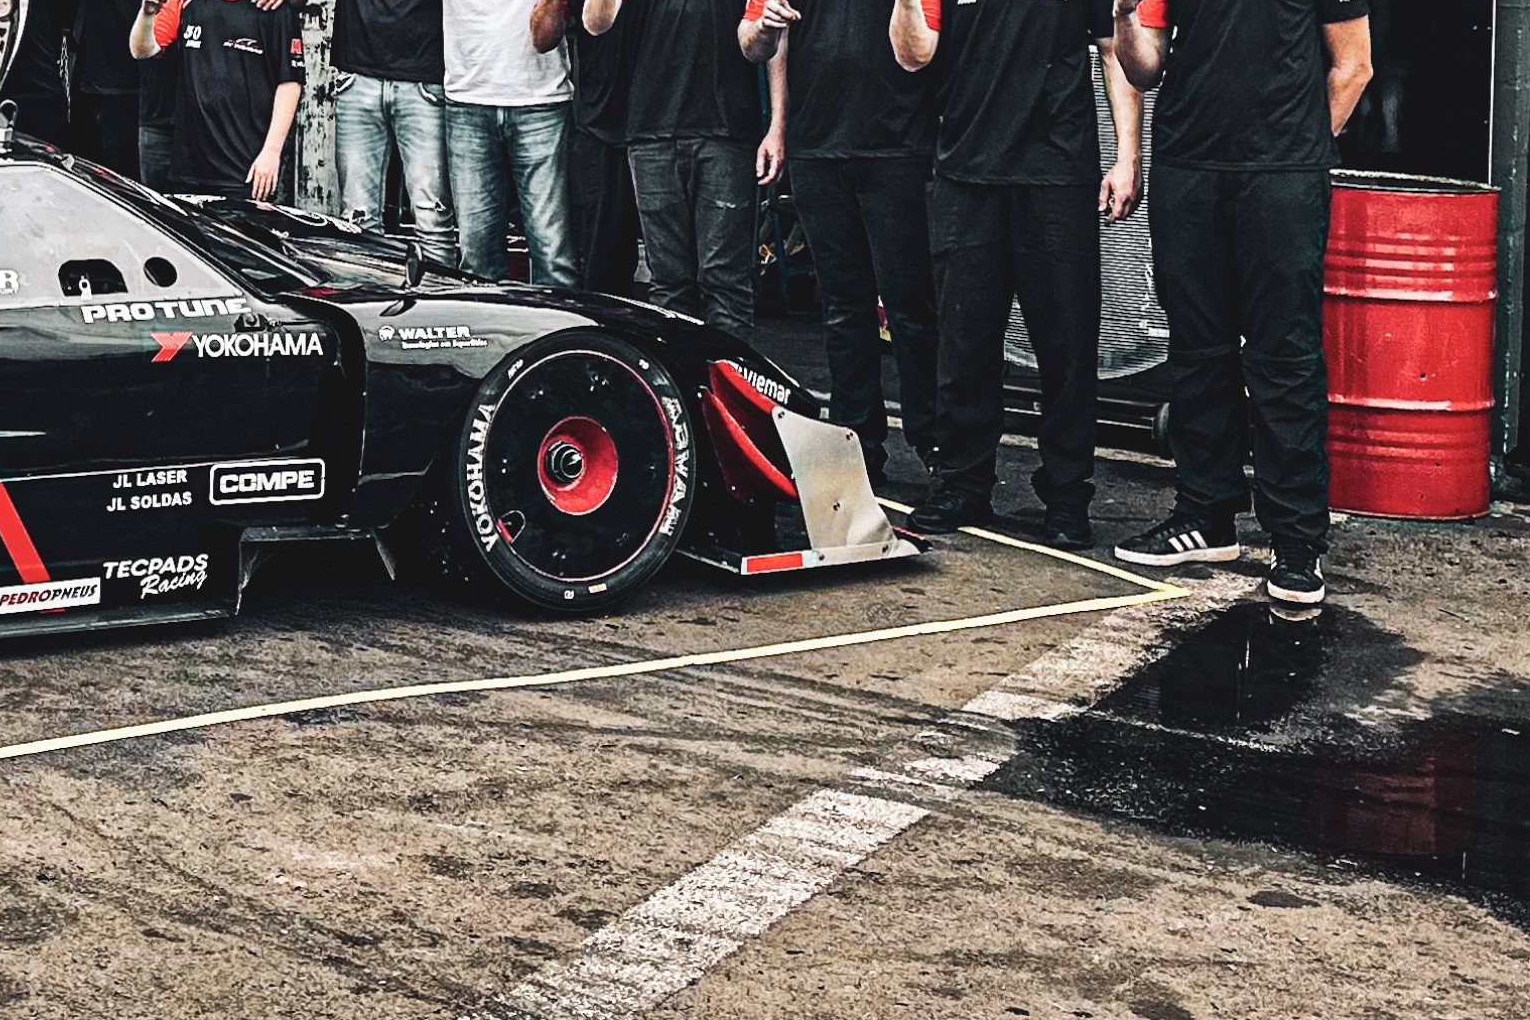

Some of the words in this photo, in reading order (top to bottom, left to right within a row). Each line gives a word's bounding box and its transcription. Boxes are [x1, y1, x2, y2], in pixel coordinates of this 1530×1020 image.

[183, 24, 202, 40] 50
[398, 326, 471, 340] WALTER
[192, 333, 324, 358] YOKOHAMA
[113, 475, 132, 488] JL
[137, 469, 188, 487] LASER
[220, 470, 315, 493] COMPE
[466, 403, 498, 553] YOKOHAMA
[106, 498, 127, 512] JL
[130, 491, 193, 510] SOLDAS
[103, 554, 209, 580] TECPADS
[140, 572, 208, 600] Racing
